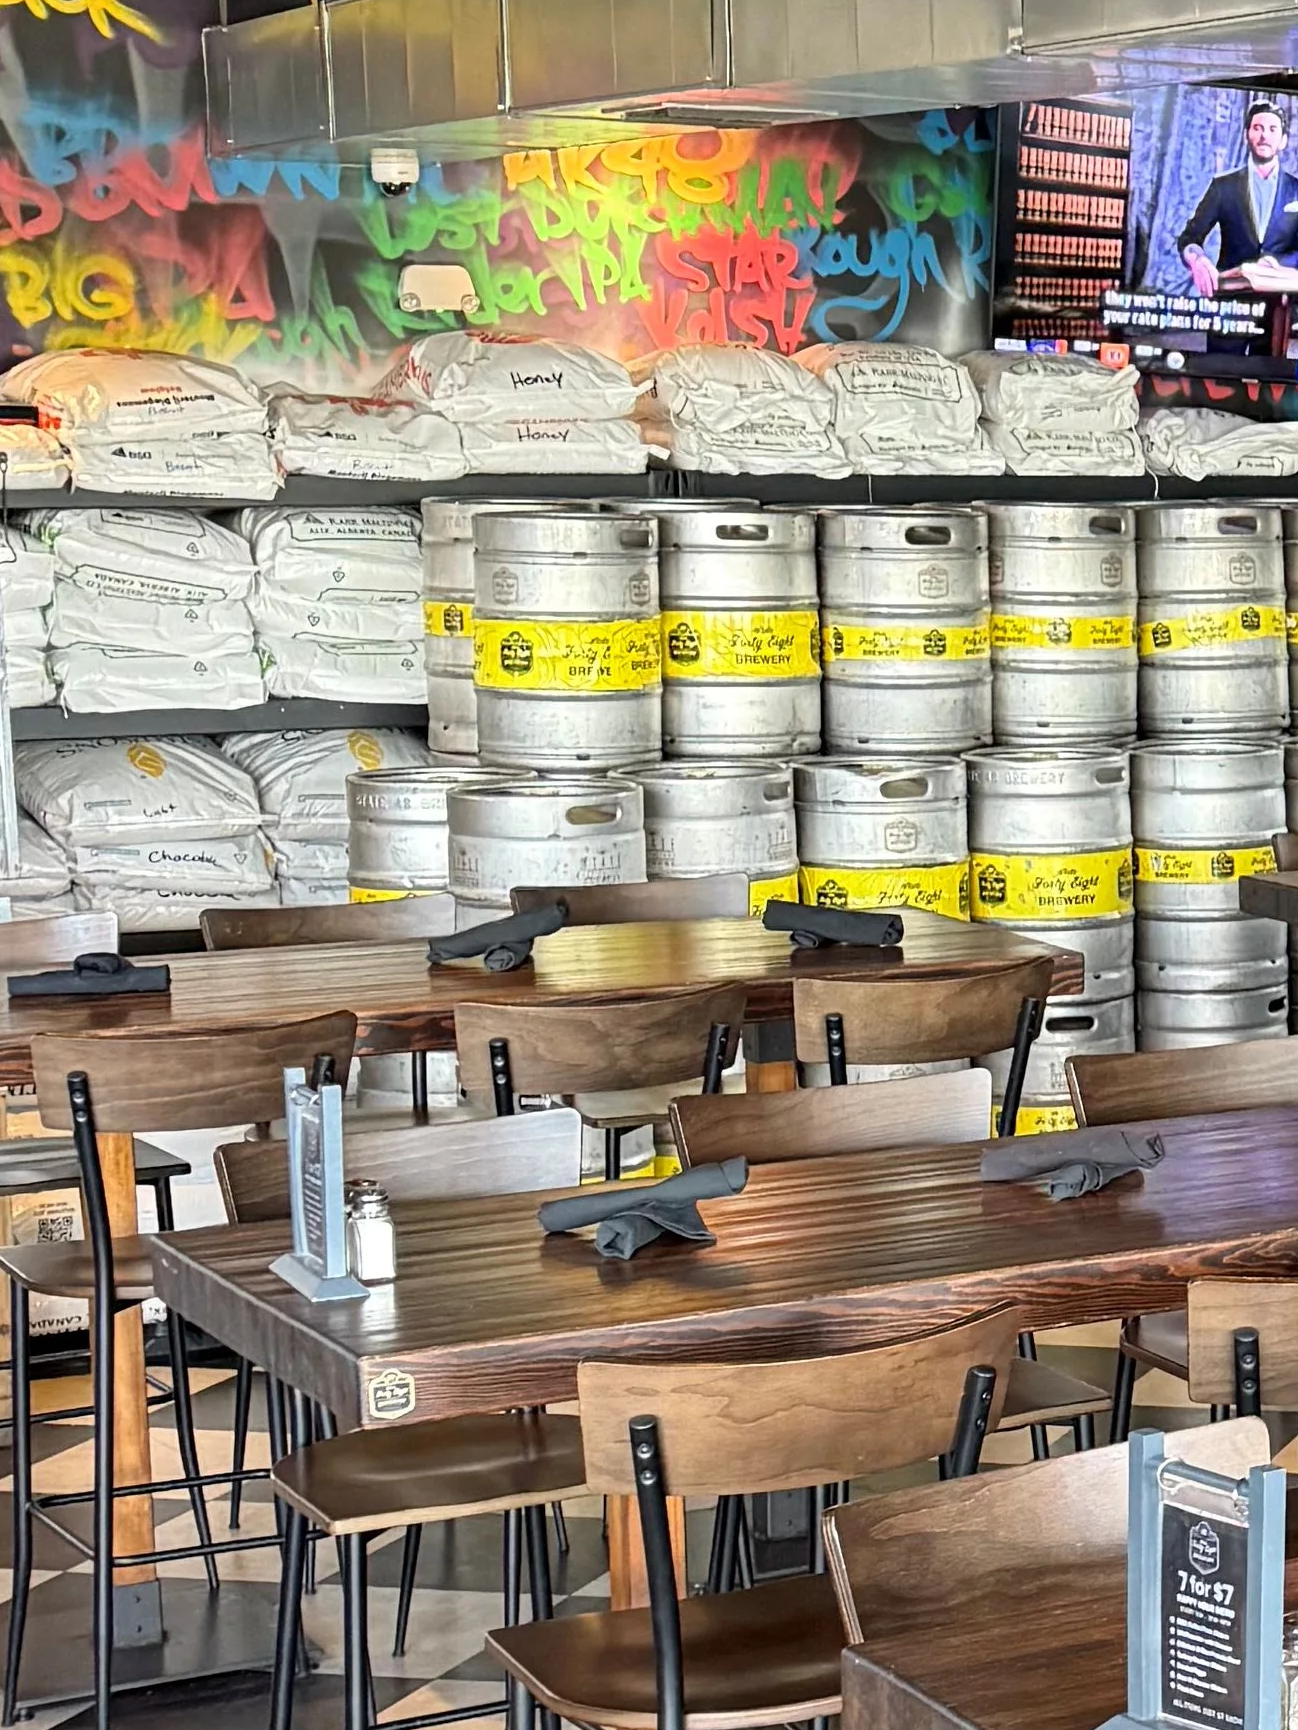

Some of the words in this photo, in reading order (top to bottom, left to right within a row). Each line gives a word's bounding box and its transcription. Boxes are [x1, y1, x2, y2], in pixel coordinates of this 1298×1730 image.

[0, 244, 137, 329] BIG
[1105, 290, 1131, 309] they
[1166, 295, 1196, 313] raise
[1199, 297, 1218, 315] the
[1220, 299, 1250, 317] price
[1252, 302, 1266, 318] of
[1104, 310, 1130, 325] your
[1132, 312, 1158, 326] rate
[1160, 313, 1191, 328] plans
[1193, 315, 1211, 329] for
[511, 372, 563, 389] Honey
[517, 426, 570, 442] Honey
[735, 654, 792, 665] BREWERY
[1005, 771, 1066, 786] BREWERY
[1032, 876, 1066, 894] Forty
[1070, 876, 1099, 892] Eight
[914, 889, 942, 905] Eight
[1038, 894, 1096, 906] BREWERY
[1177, 1569, 1188, 1591] 7
[1189, 1574, 1211, 1597] for
[1213, 1581, 1235, 1605] $7
